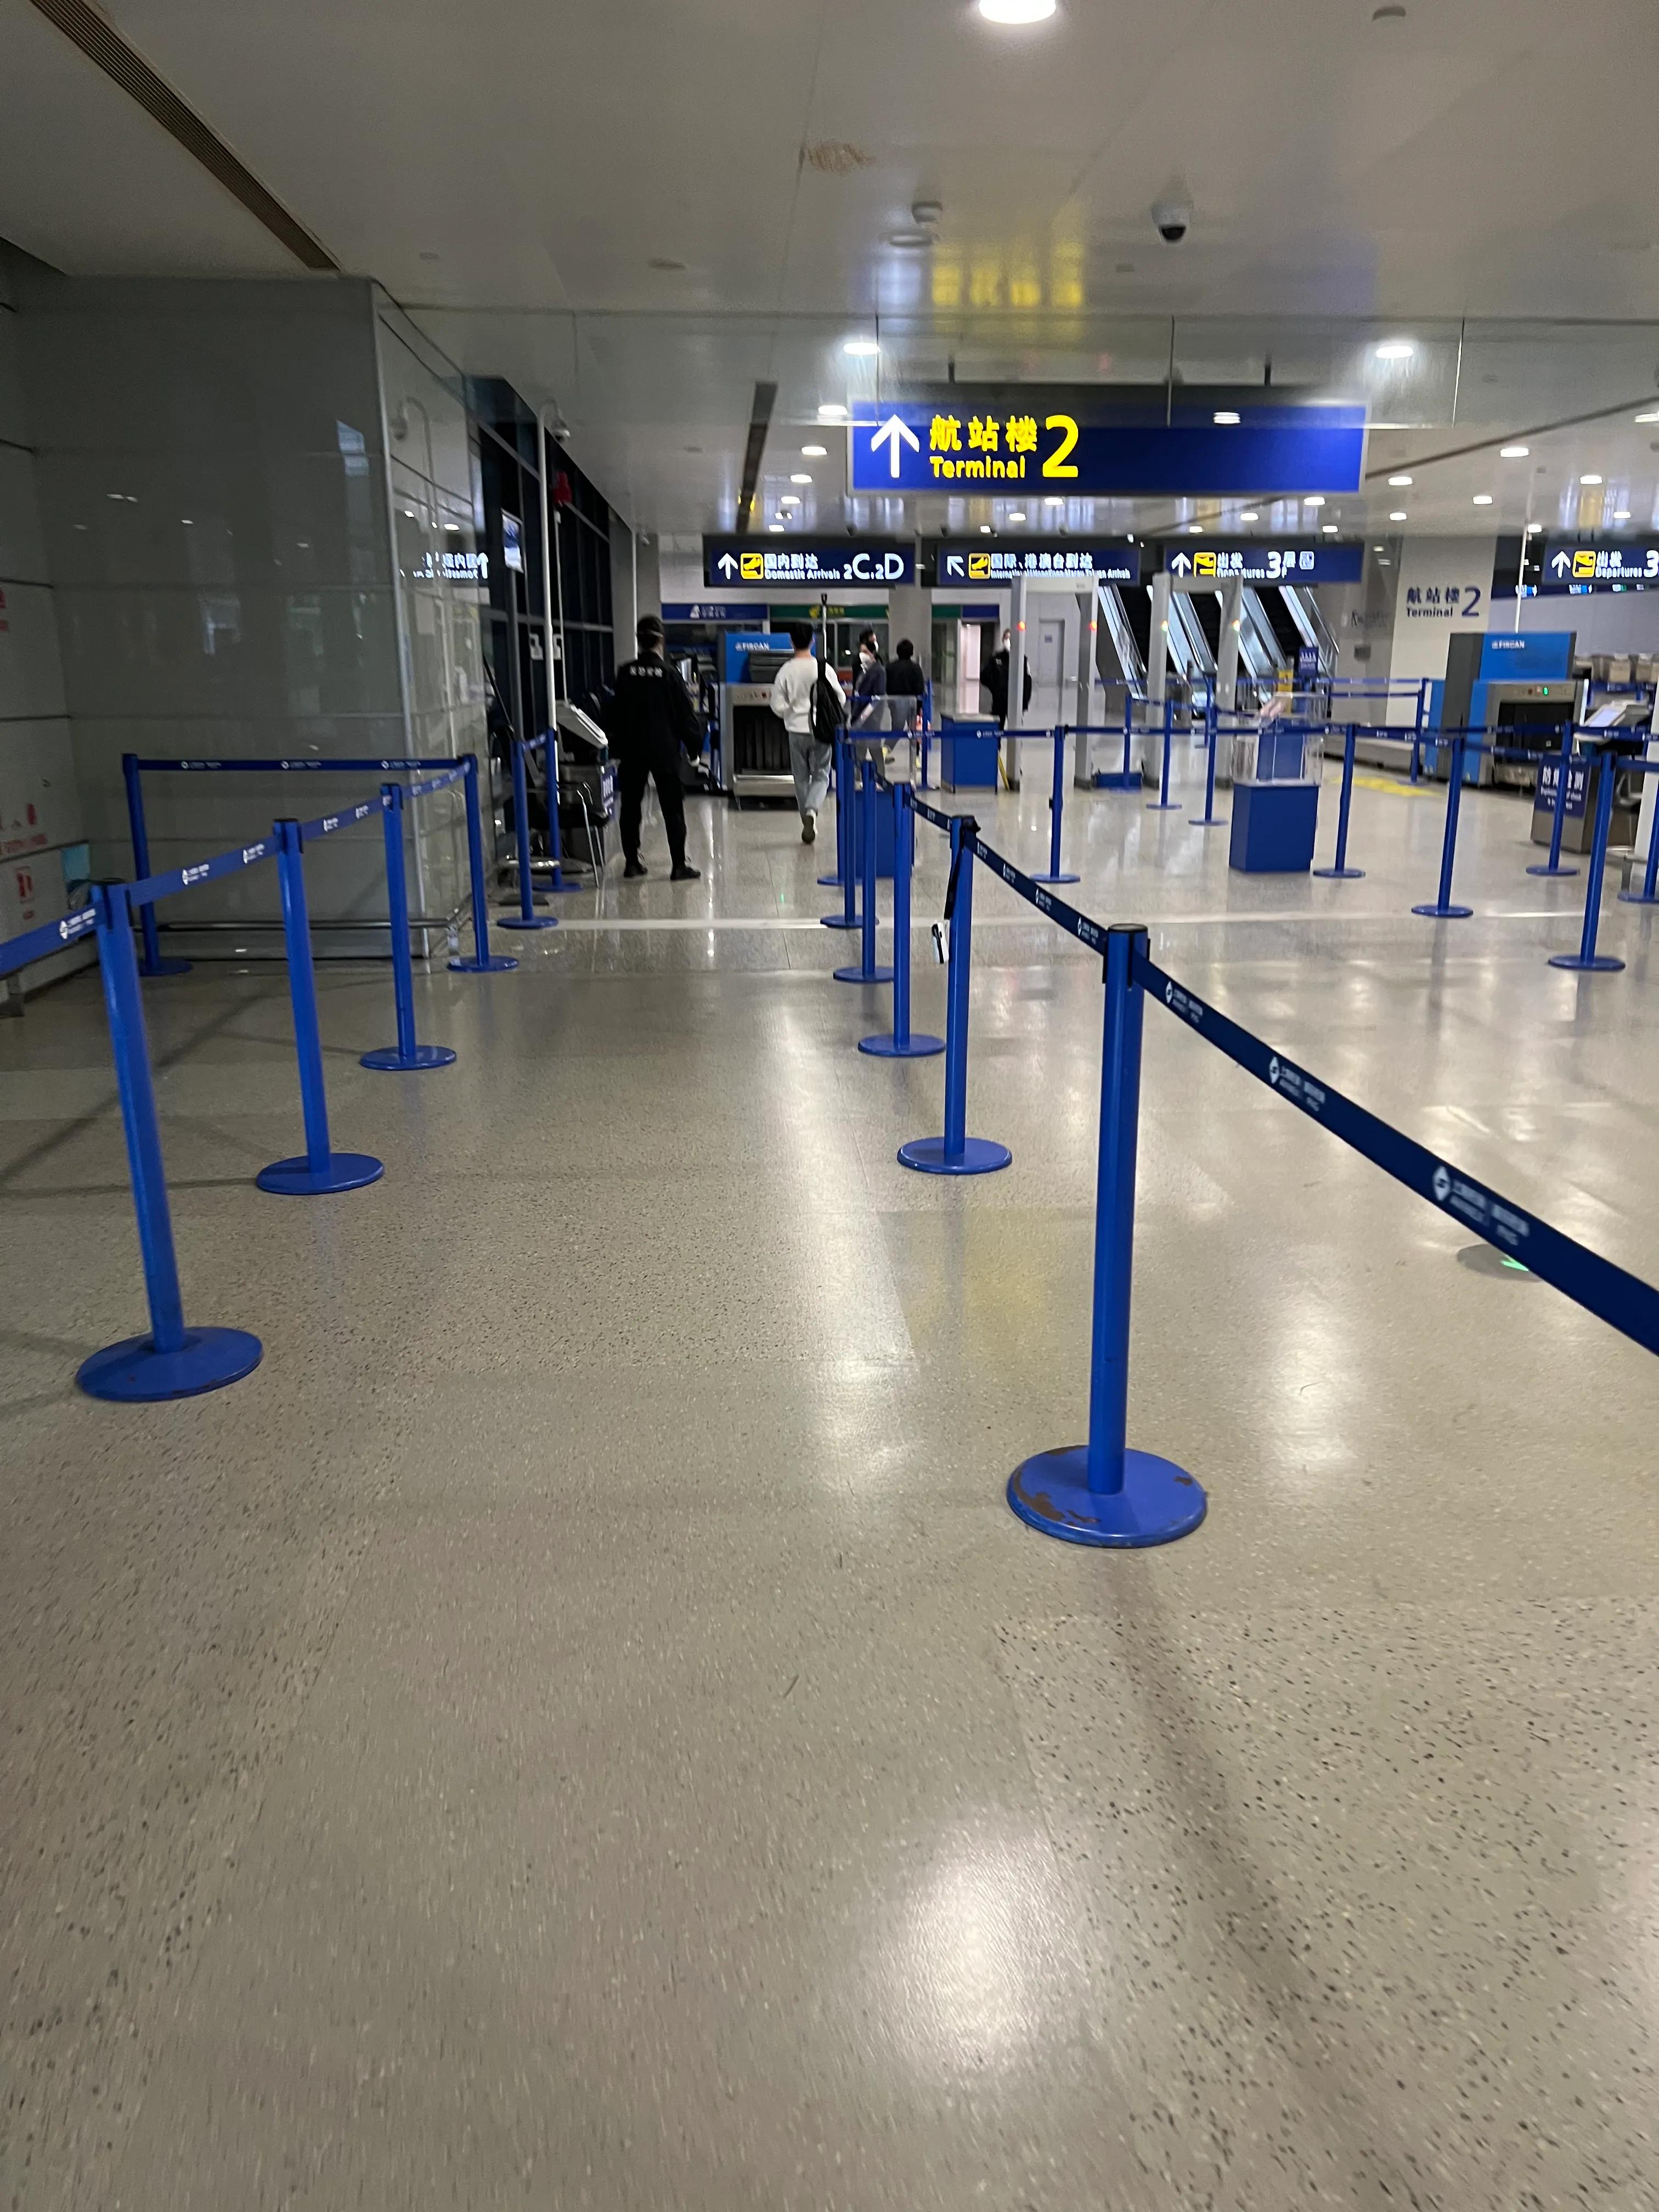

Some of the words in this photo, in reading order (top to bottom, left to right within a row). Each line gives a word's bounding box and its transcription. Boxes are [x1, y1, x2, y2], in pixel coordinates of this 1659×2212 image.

[930, 415, 1037, 453] 航站楼
[1042, 415, 1079, 477] 2
[929, 455, 1025, 478] Terminal
[764, 553, 818, 569] 国内到达
[1266, 551, 1281, 578] 3
[1644, 550, 1659, 577] 3
[765, 569, 805, 579] Domestic
[807, 568, 840, 579] Arrivals
[1595, 567, 1643, 579] Departures
[1407, 587, 1460, 603] 航站楼
[1462, 586, 1481, 617] 2
[1407, 606, 1453, 617] Terminal
